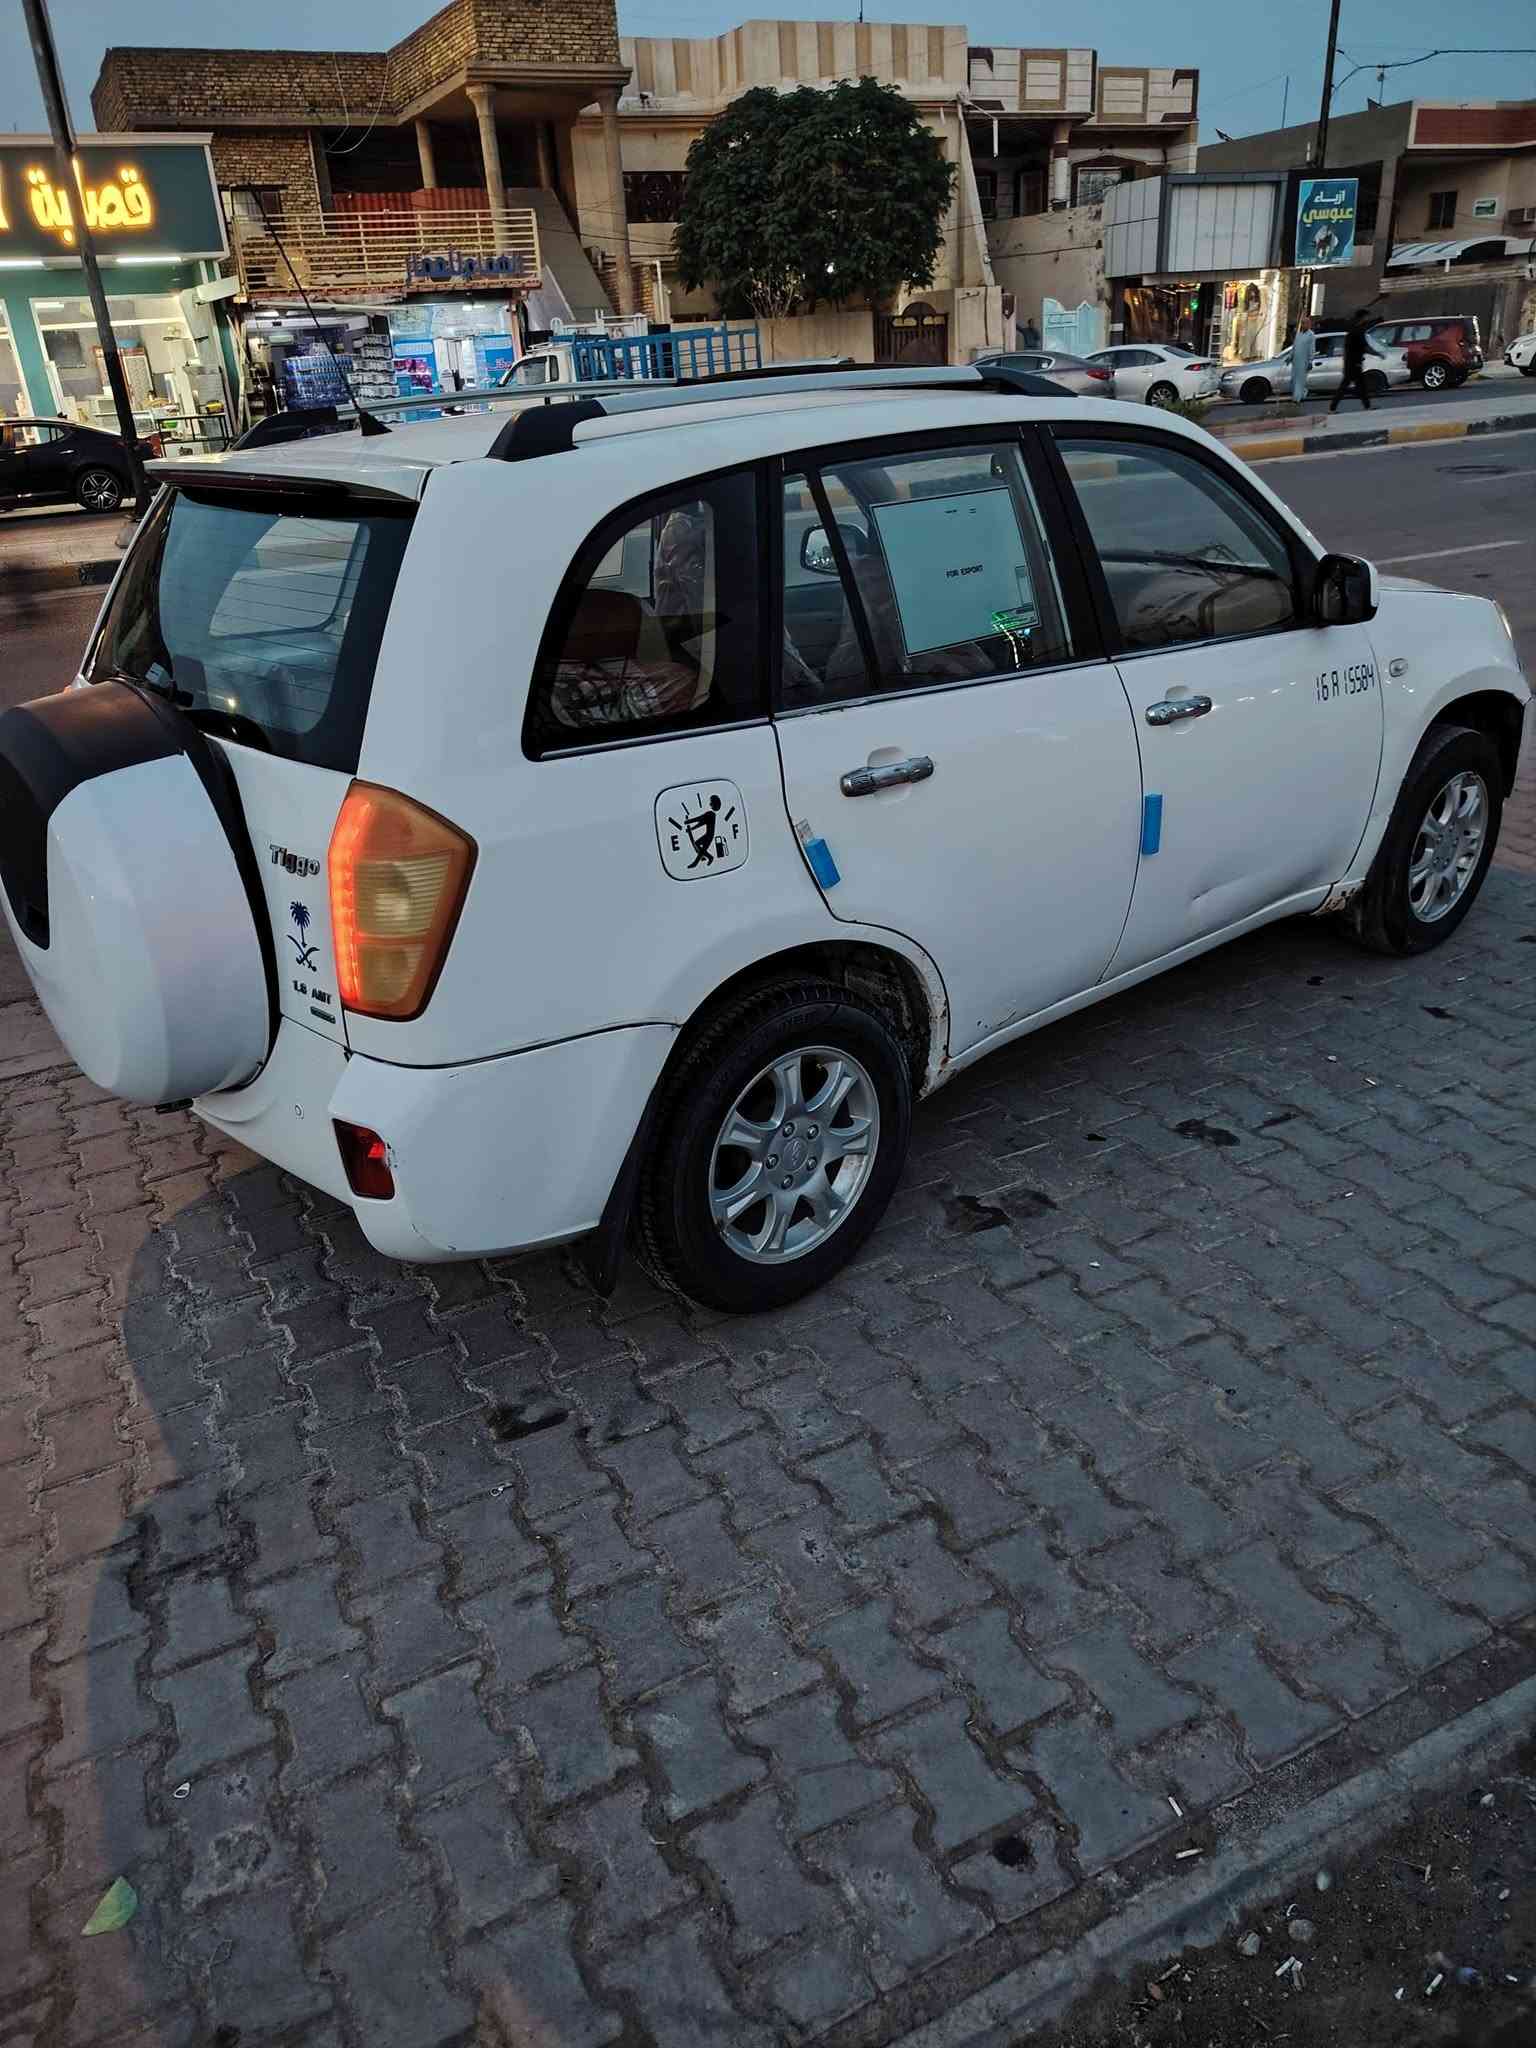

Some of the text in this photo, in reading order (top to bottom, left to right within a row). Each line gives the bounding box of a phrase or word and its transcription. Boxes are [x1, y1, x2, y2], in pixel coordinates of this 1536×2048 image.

[1302, 207, 1354, 228] عبوسي
[945, 564, 984, 579] FOR EXPORT
[1316, 673, 1329, 704] 16
[1343, 663, 1375, 695] 15584
[732, 823, 740, 840] F
[670, 835, 681, 852] E
[268, 843, 321, 877] Tiggo
